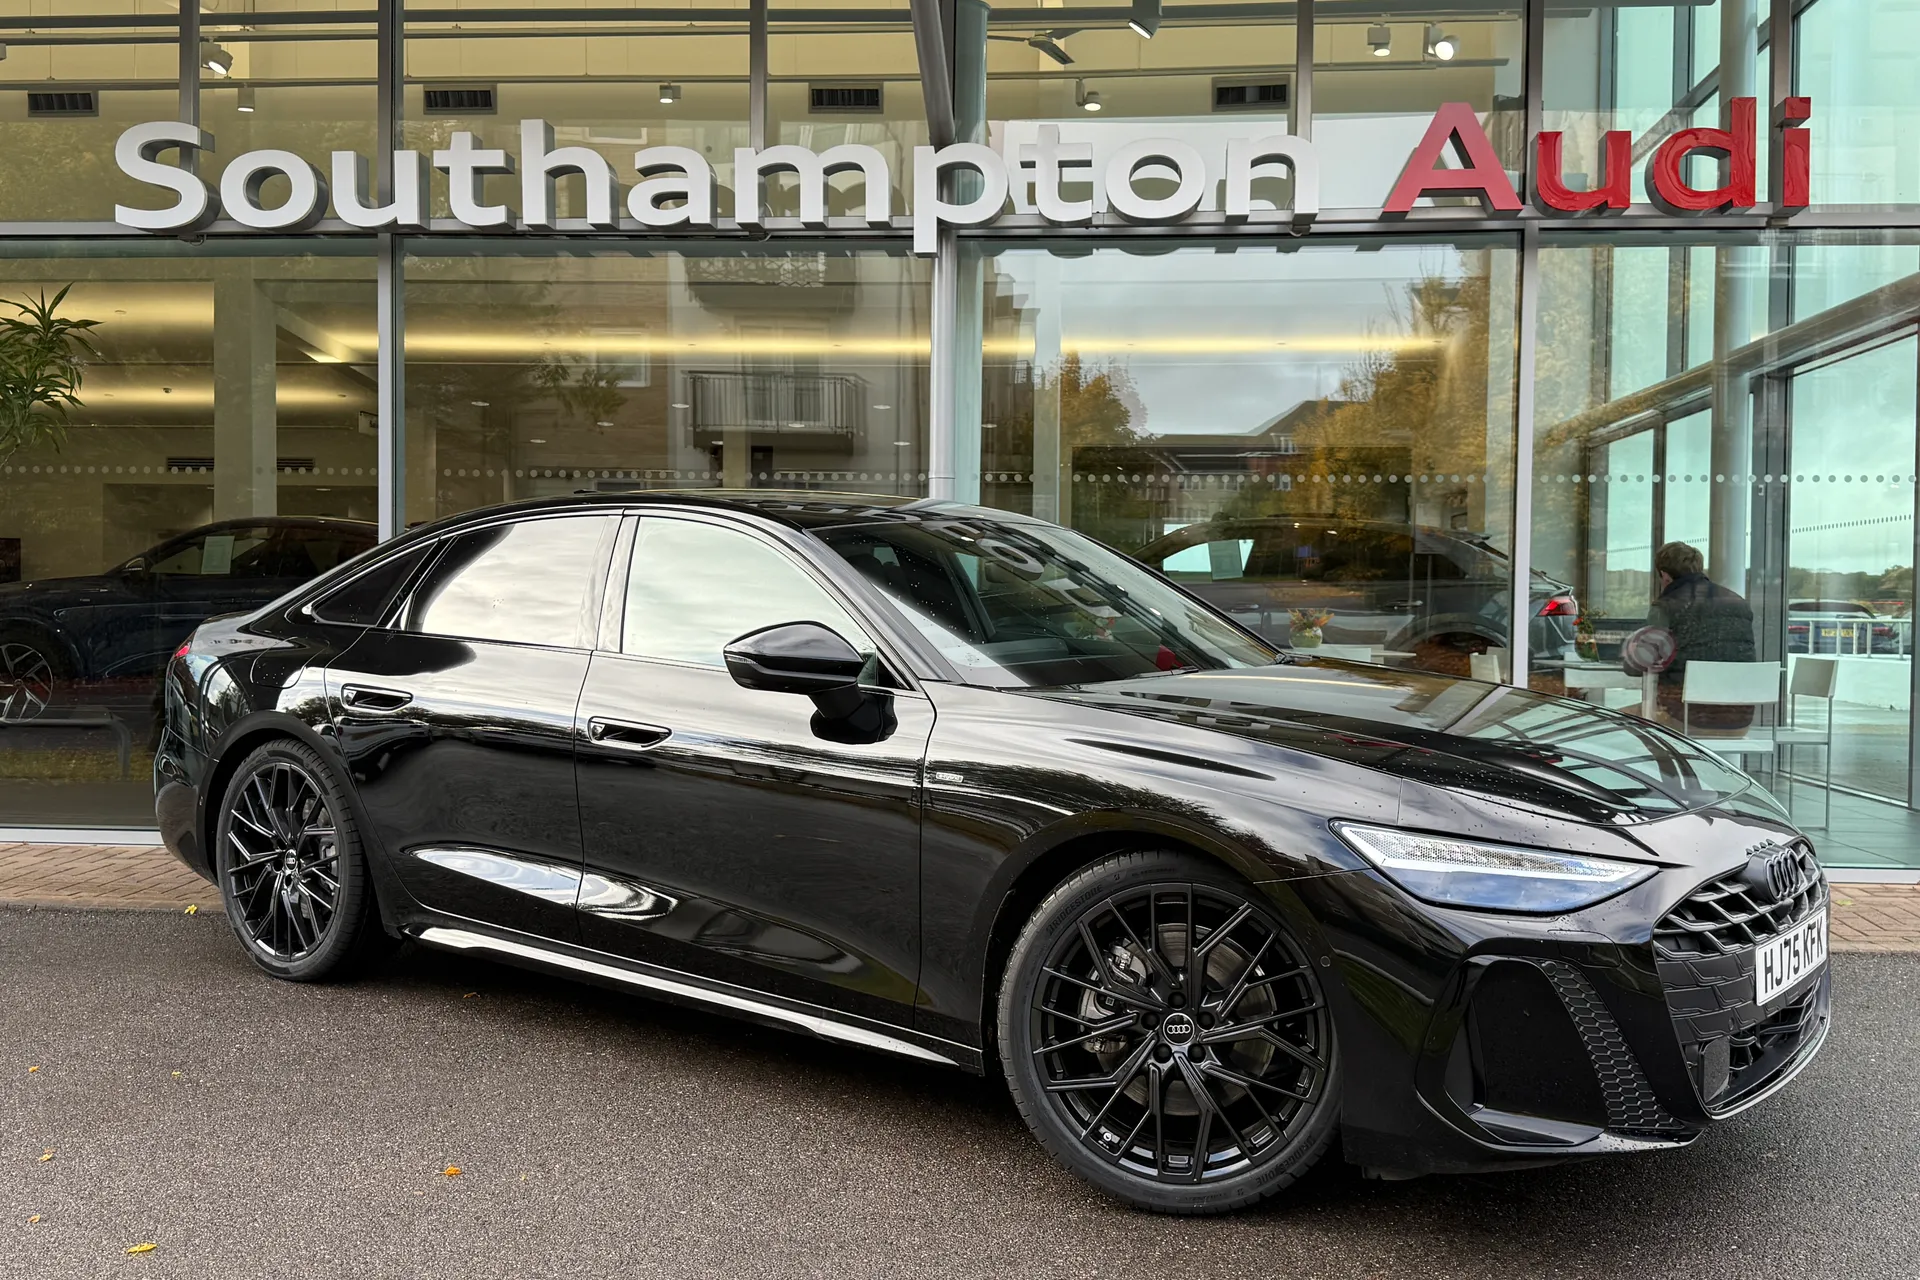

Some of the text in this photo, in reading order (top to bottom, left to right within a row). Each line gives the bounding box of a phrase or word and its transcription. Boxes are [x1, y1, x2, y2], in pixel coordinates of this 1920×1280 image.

[114, 96, 1811, 256] Southampton Audi
[1046, 884, 1104, 936] BRIDGESTONE
[1763, 915, 1823, 994] HJ75 KFK
